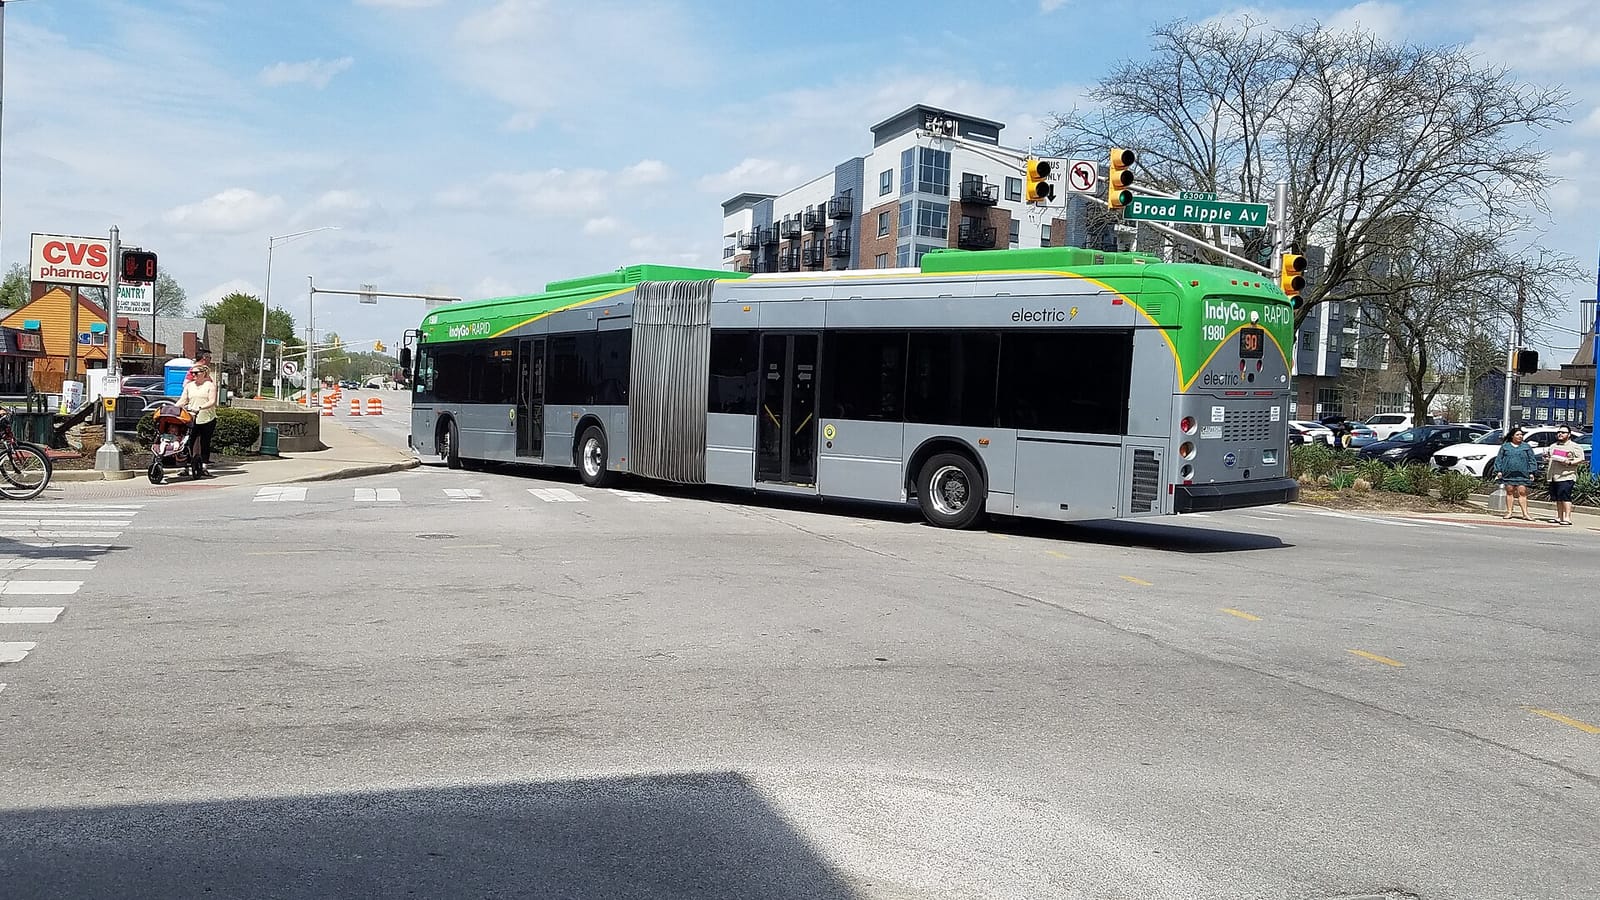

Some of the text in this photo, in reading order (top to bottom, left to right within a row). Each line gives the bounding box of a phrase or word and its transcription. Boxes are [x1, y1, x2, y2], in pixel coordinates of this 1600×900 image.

[1047, 172, 1061, 181] NLY
[1183, 192, 1204, 200] 6300
[1132, 202, 1258, 222] Broad Ripple Av
[43, 241, 108, 267] CVS
[40, 266, 109, 282] pharmacy
[1011, 307, 1065, 322] electric
[1205, 300, 1290, 324] IndyGo RAPID
[449, 321, 491, 340] IndyGo RAPID
[1202, 325, 1226, 340] 1980
[1245, 334, 1258, 351] 90
[1203, 370, 1239, 385] electric
